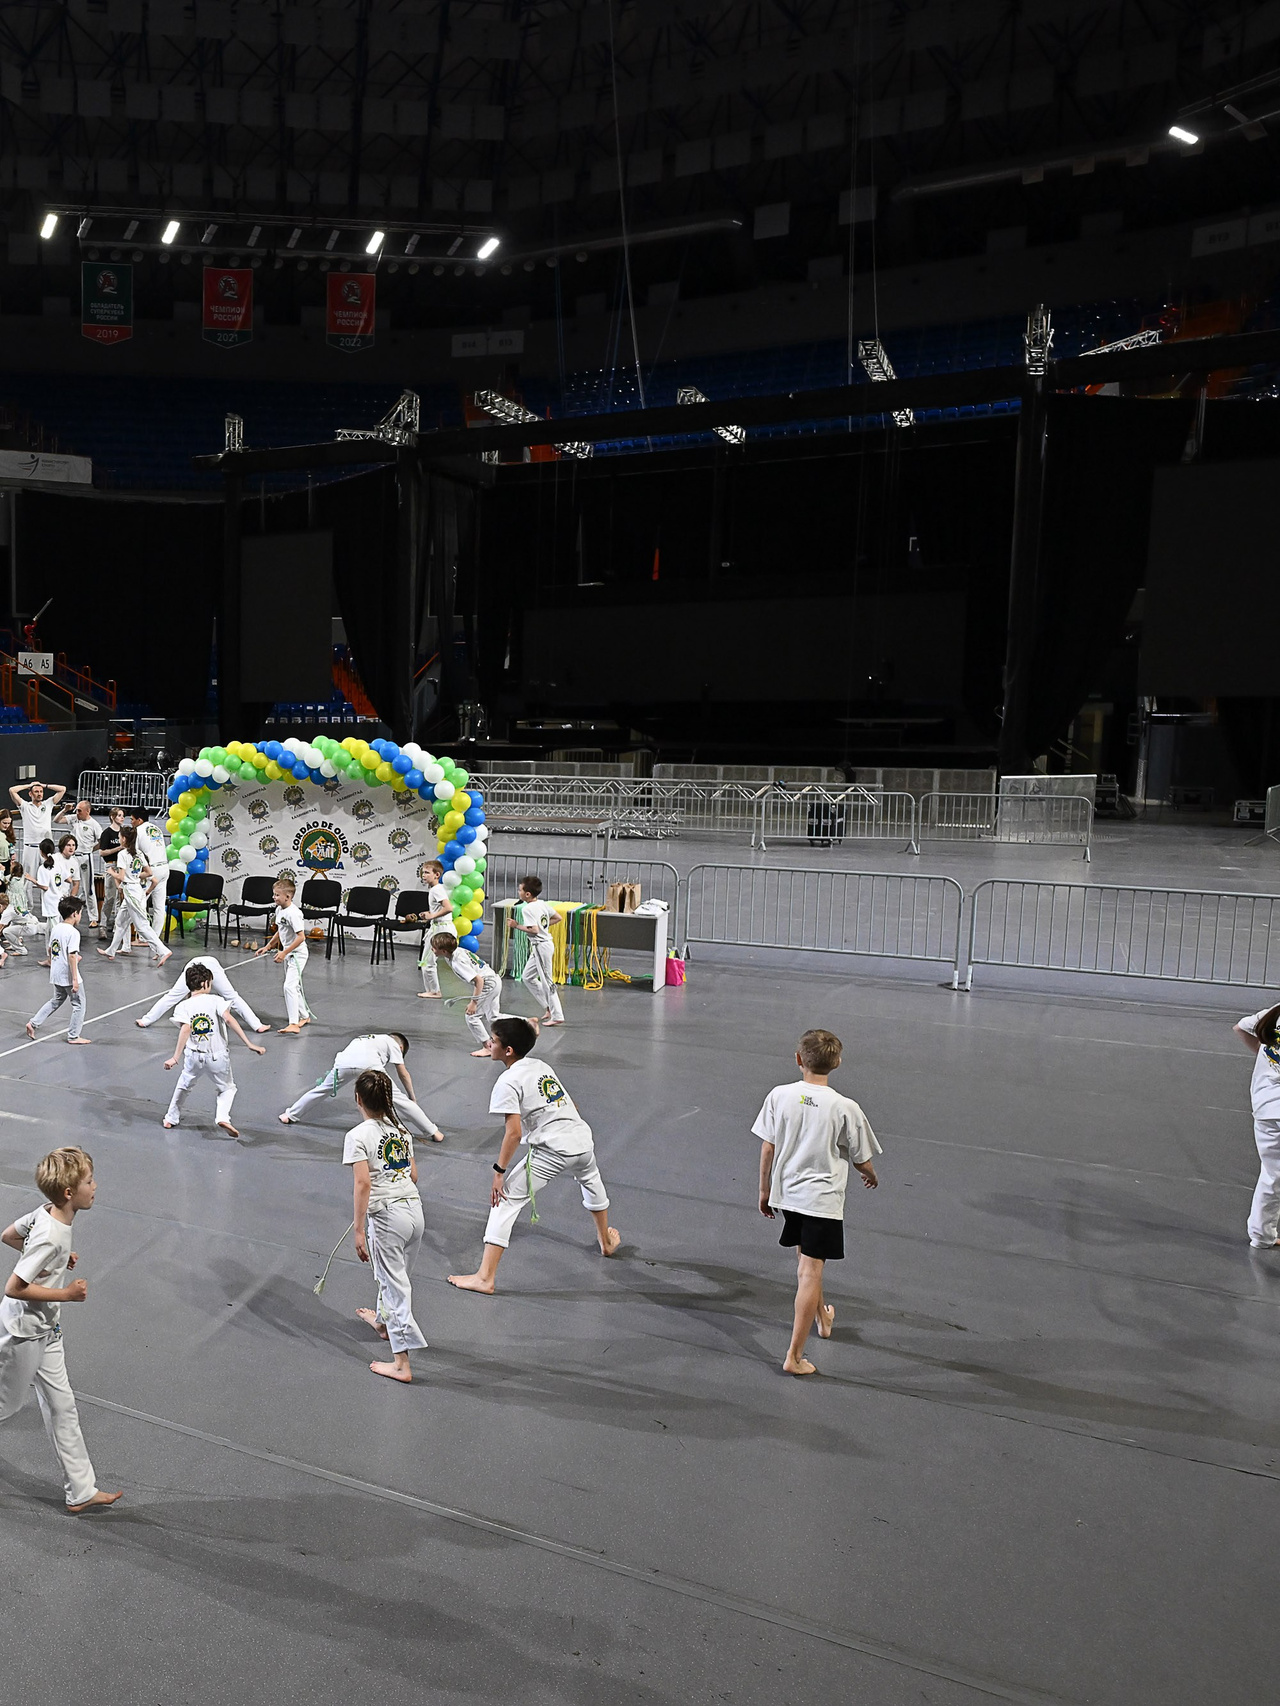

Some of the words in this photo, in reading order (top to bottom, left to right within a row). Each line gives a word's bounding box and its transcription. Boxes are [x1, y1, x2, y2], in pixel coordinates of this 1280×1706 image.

[96, 329, 119, 338] 2019
[217, 332, 239, 342] 2021
[339, 337, 362, 347] 2022
[23, 658, 33, 669] A6
[41, 659, 50, 669] A5
[292, 820, 319, 851] CORDÃO
[321, 821, 334, 830] DE
[334, 827, 349, 854] OURO
